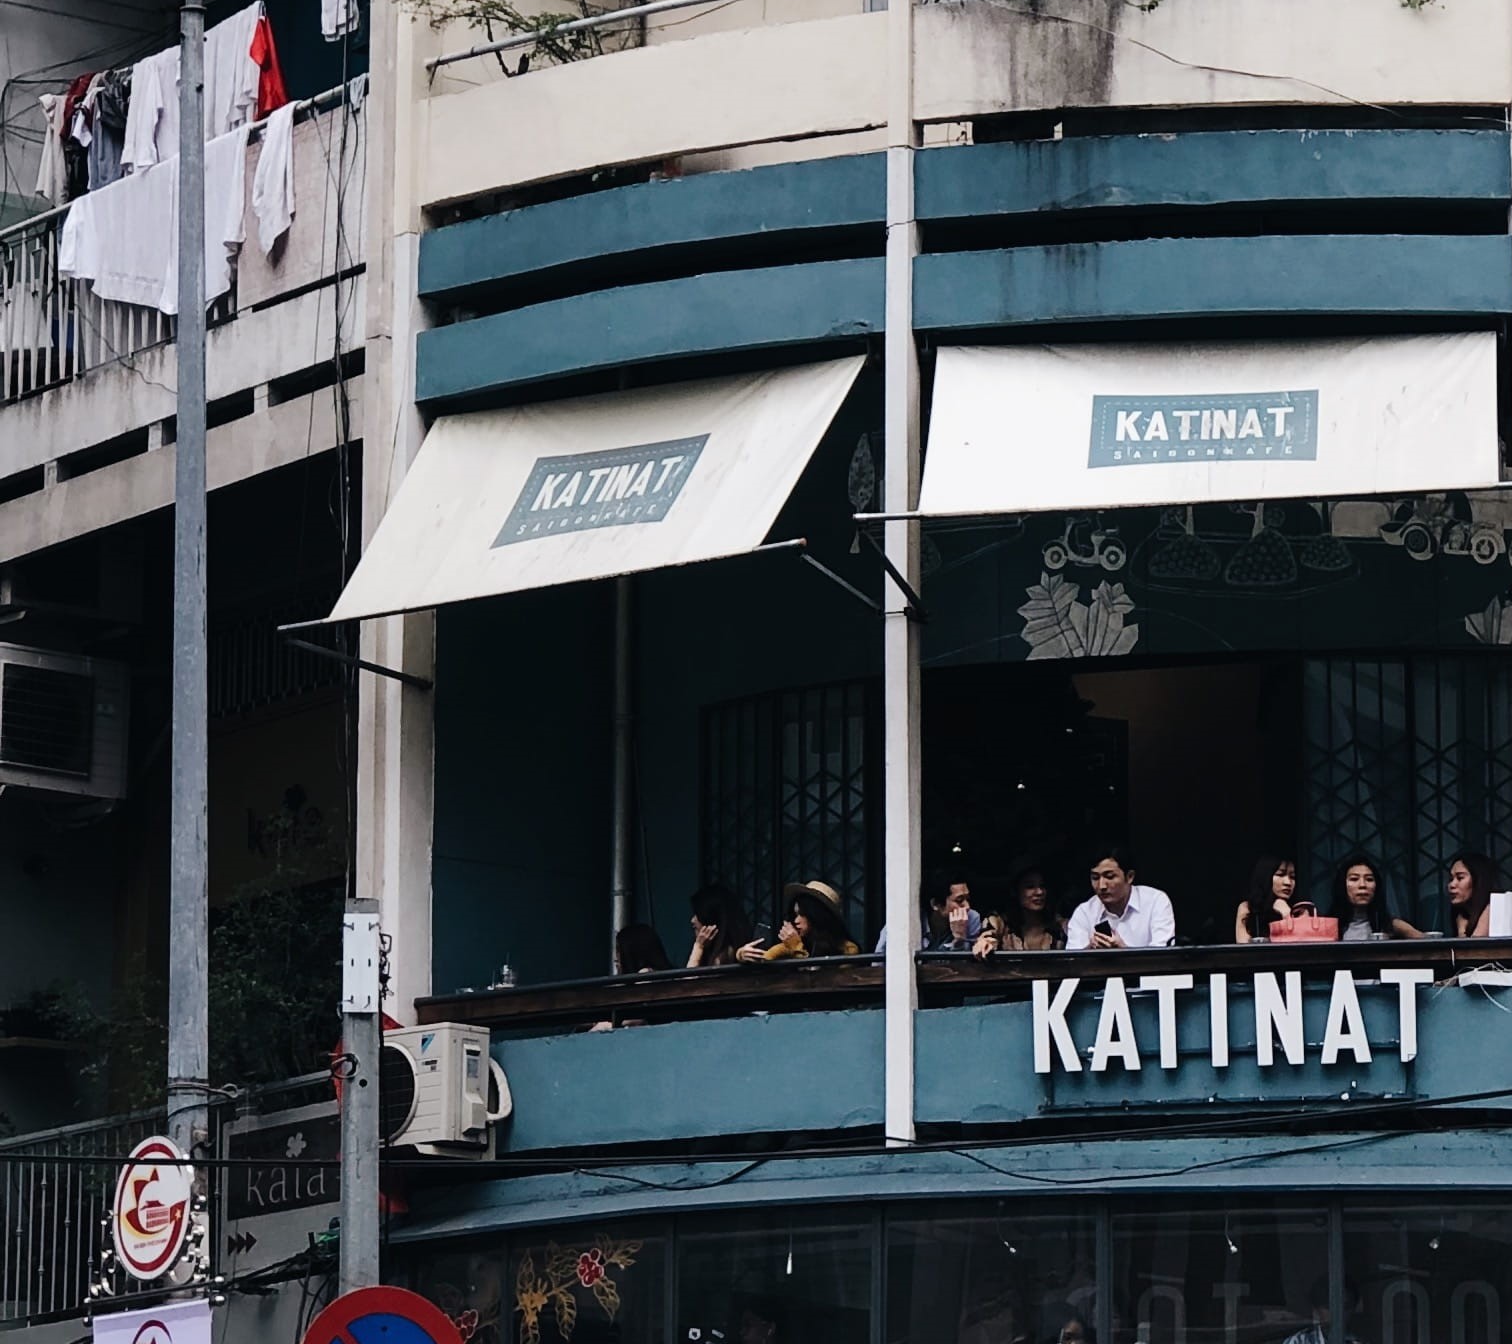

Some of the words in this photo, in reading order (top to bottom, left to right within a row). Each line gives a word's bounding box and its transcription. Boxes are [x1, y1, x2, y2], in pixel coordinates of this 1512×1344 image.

[1115, 406, 1295, 442] KATINAT
[530, 455, 687, 512] KATINAT
[1031, 968, 1435, 1074] KATINAT
